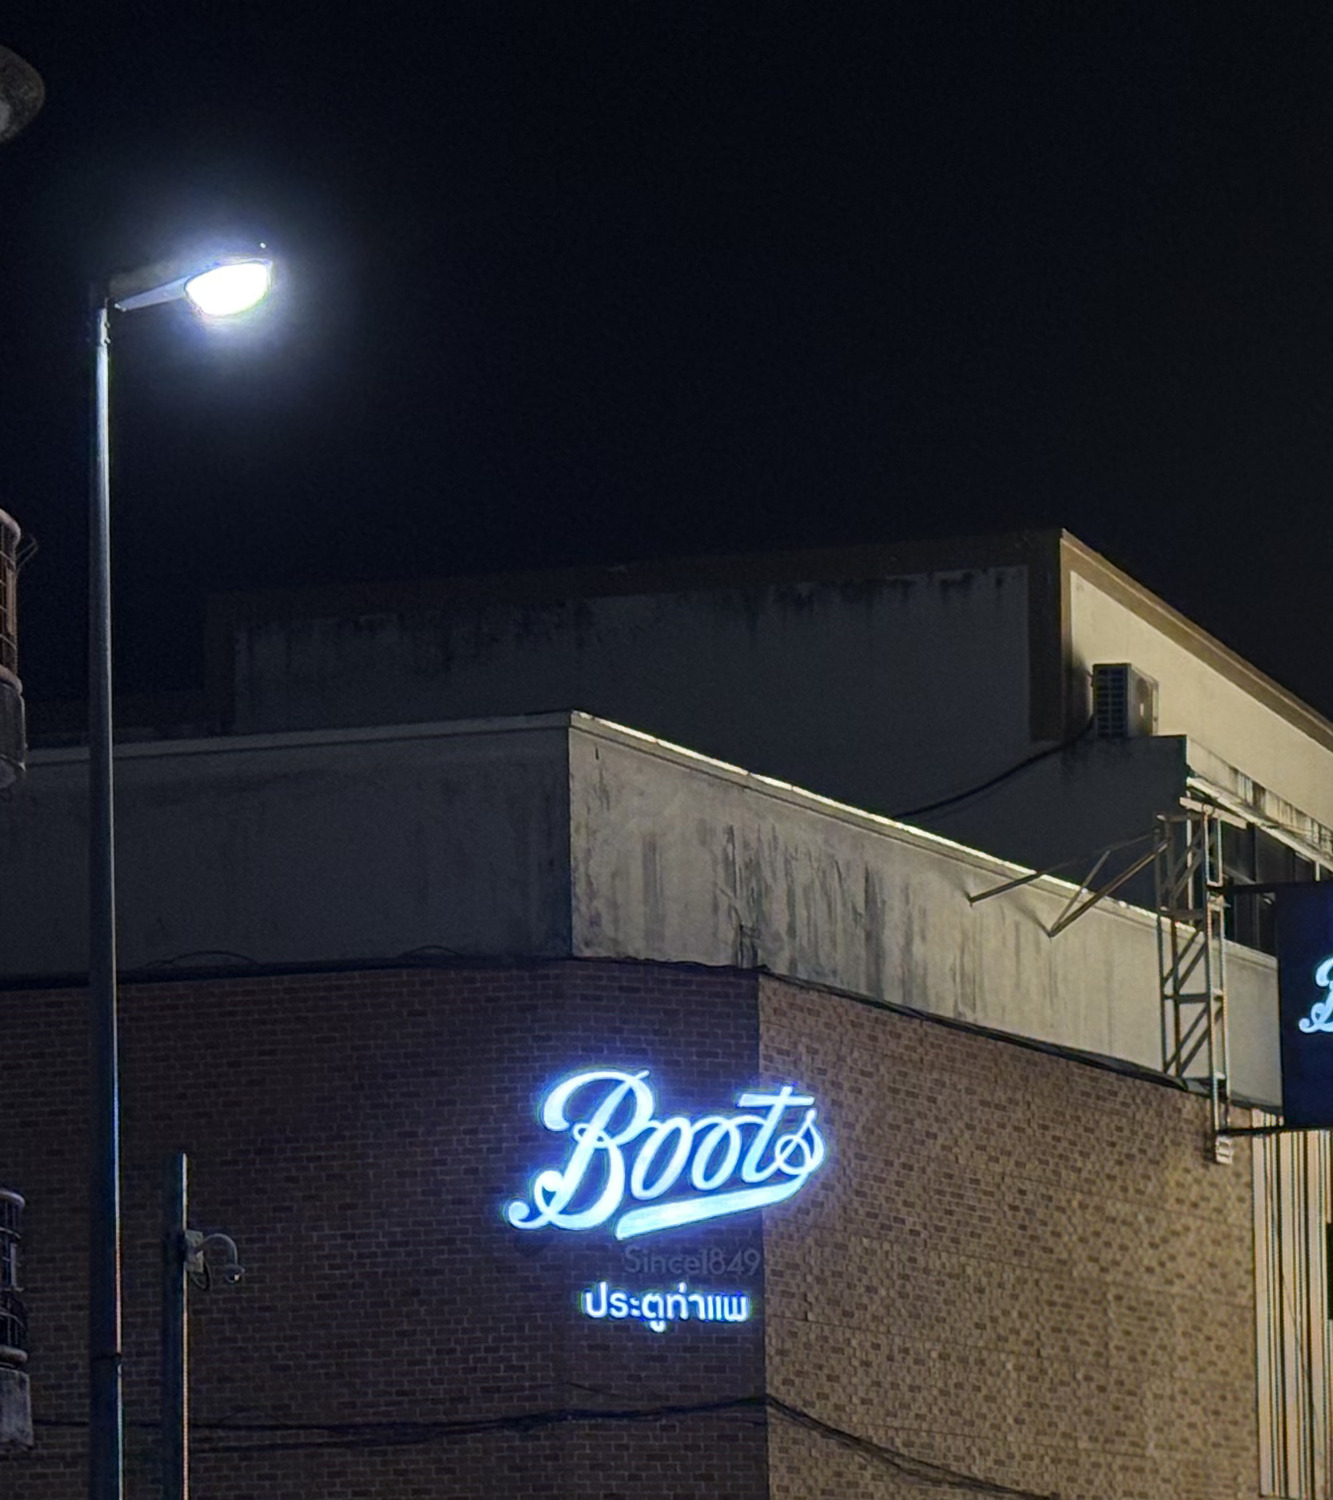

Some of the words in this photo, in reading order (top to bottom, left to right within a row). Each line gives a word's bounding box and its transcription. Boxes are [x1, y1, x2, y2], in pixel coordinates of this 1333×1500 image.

[507, 1070, 825, 1240] Boots
[582, 1281, 750, 1333] ประตูท่าแพ
